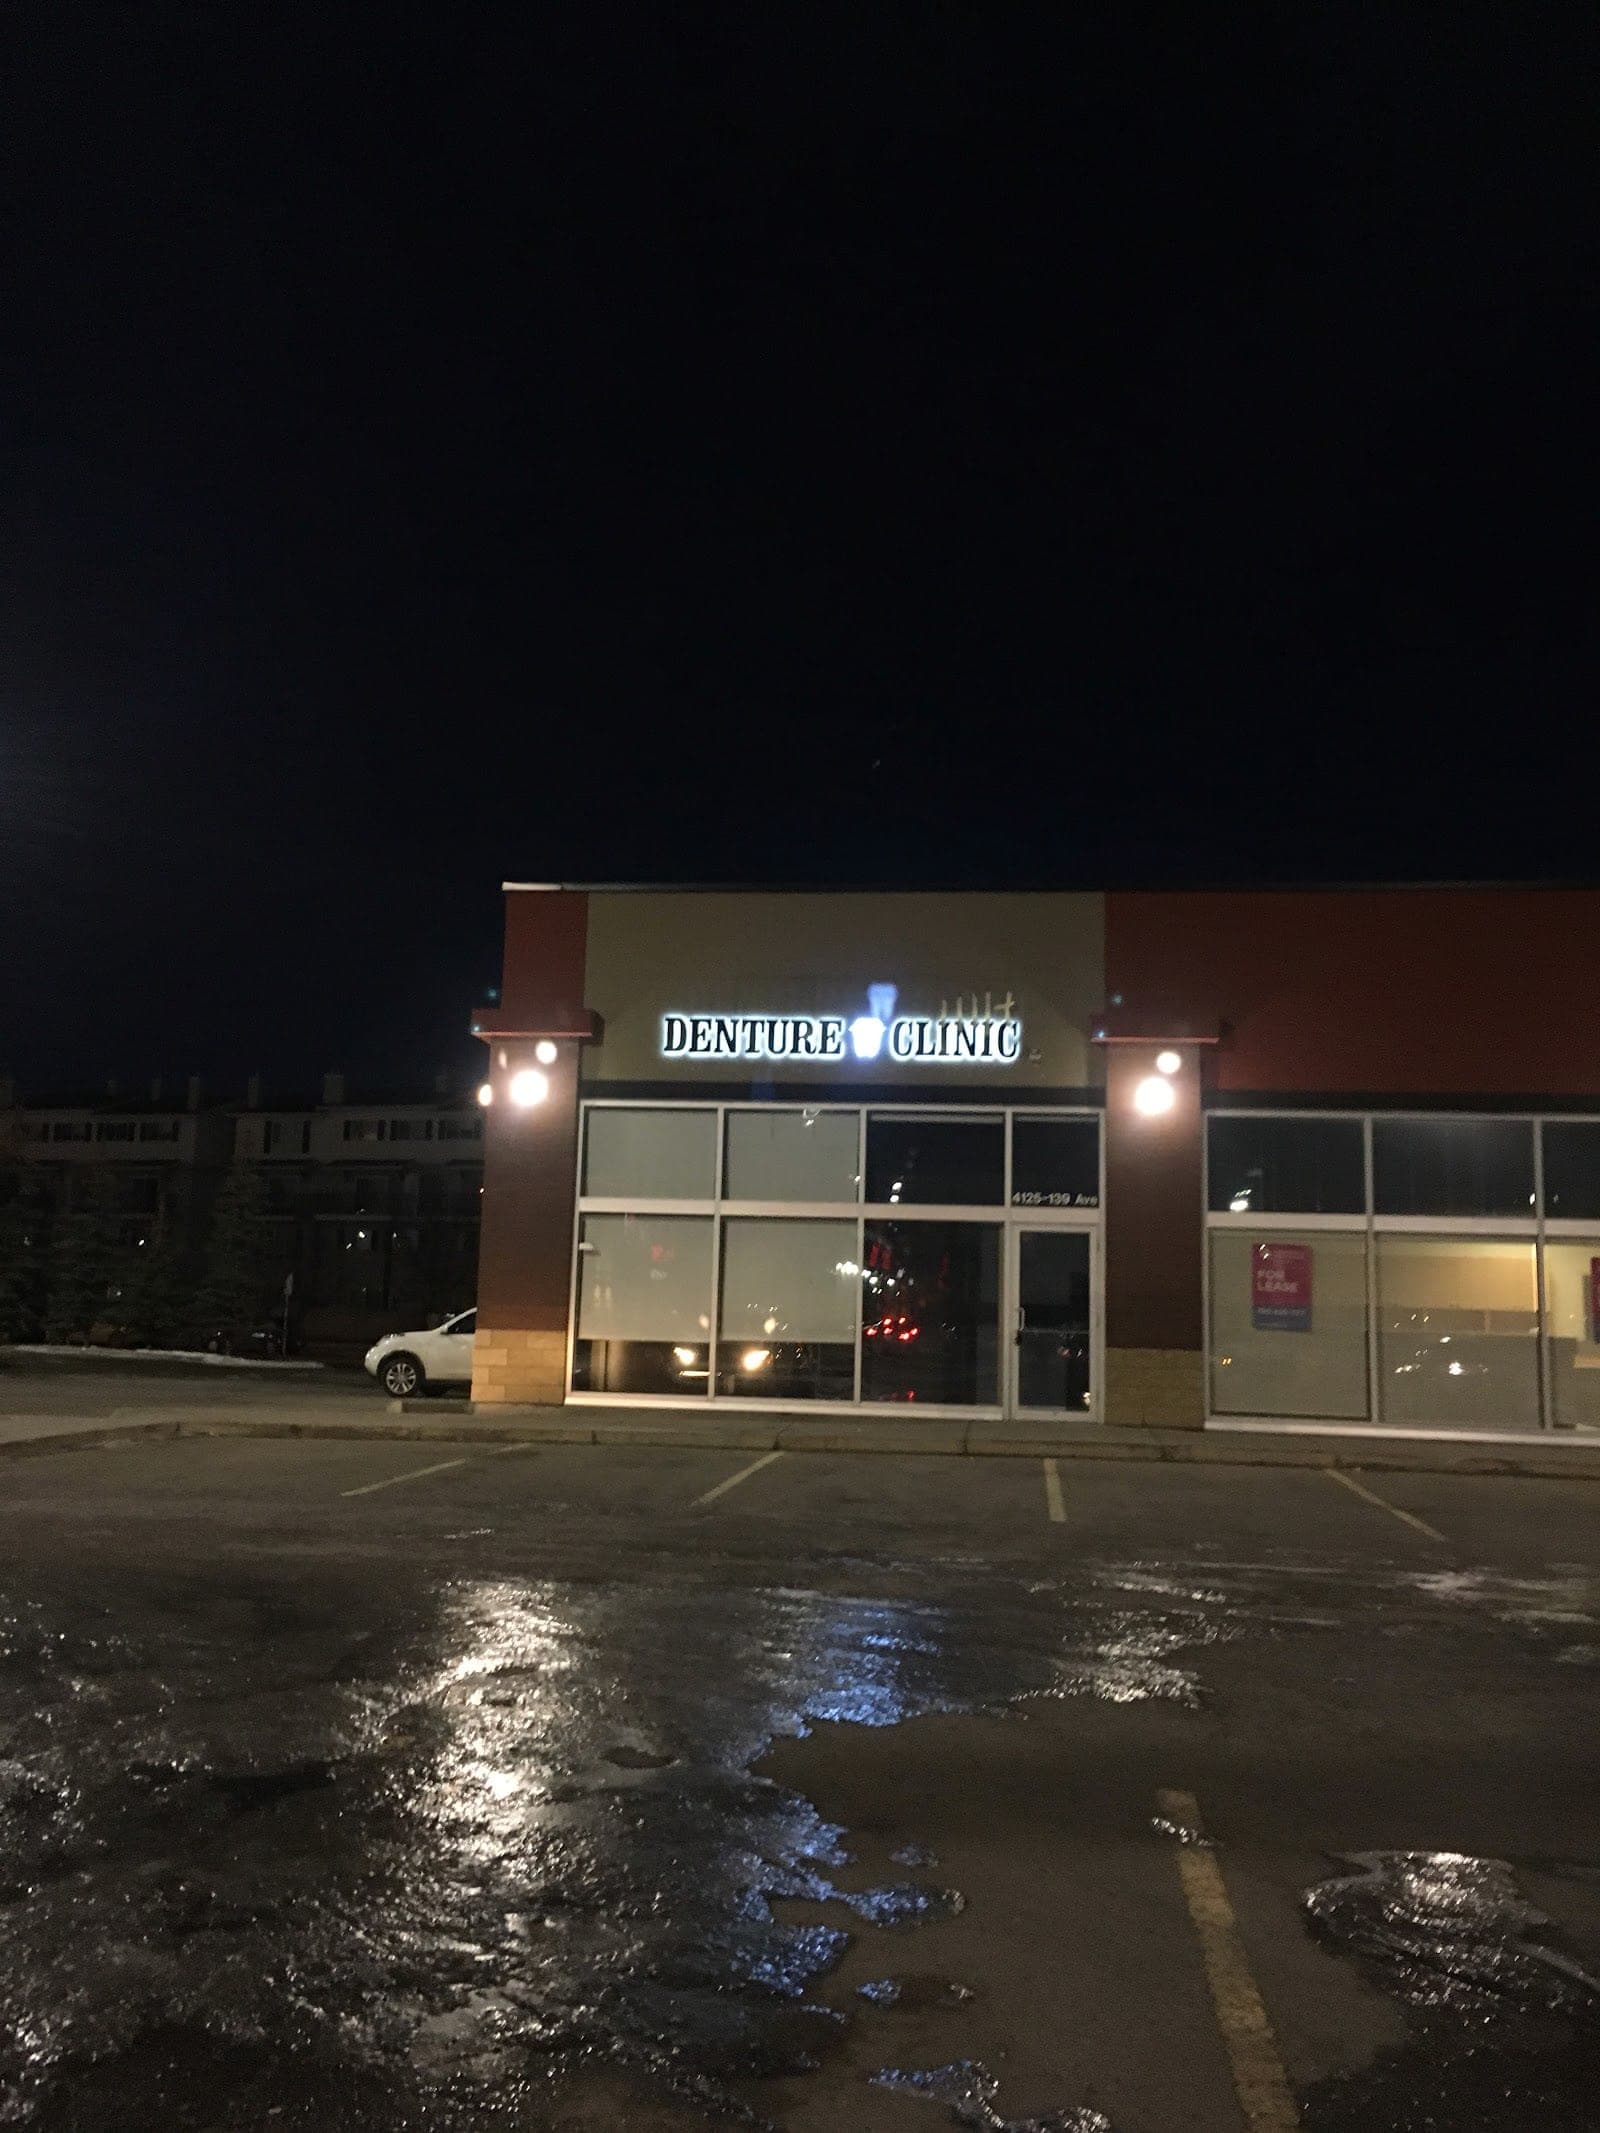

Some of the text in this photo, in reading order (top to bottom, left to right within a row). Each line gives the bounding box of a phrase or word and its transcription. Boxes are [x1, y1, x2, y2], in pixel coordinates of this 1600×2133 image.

[663, 1016, 1019, 1058] DENTURE CLINIC
[1075, 1193, 1098, 1206] Ave
[1257, 1270, 1285, 1281] FOR
[1257, 1282, 1299, 1293] LEASE
